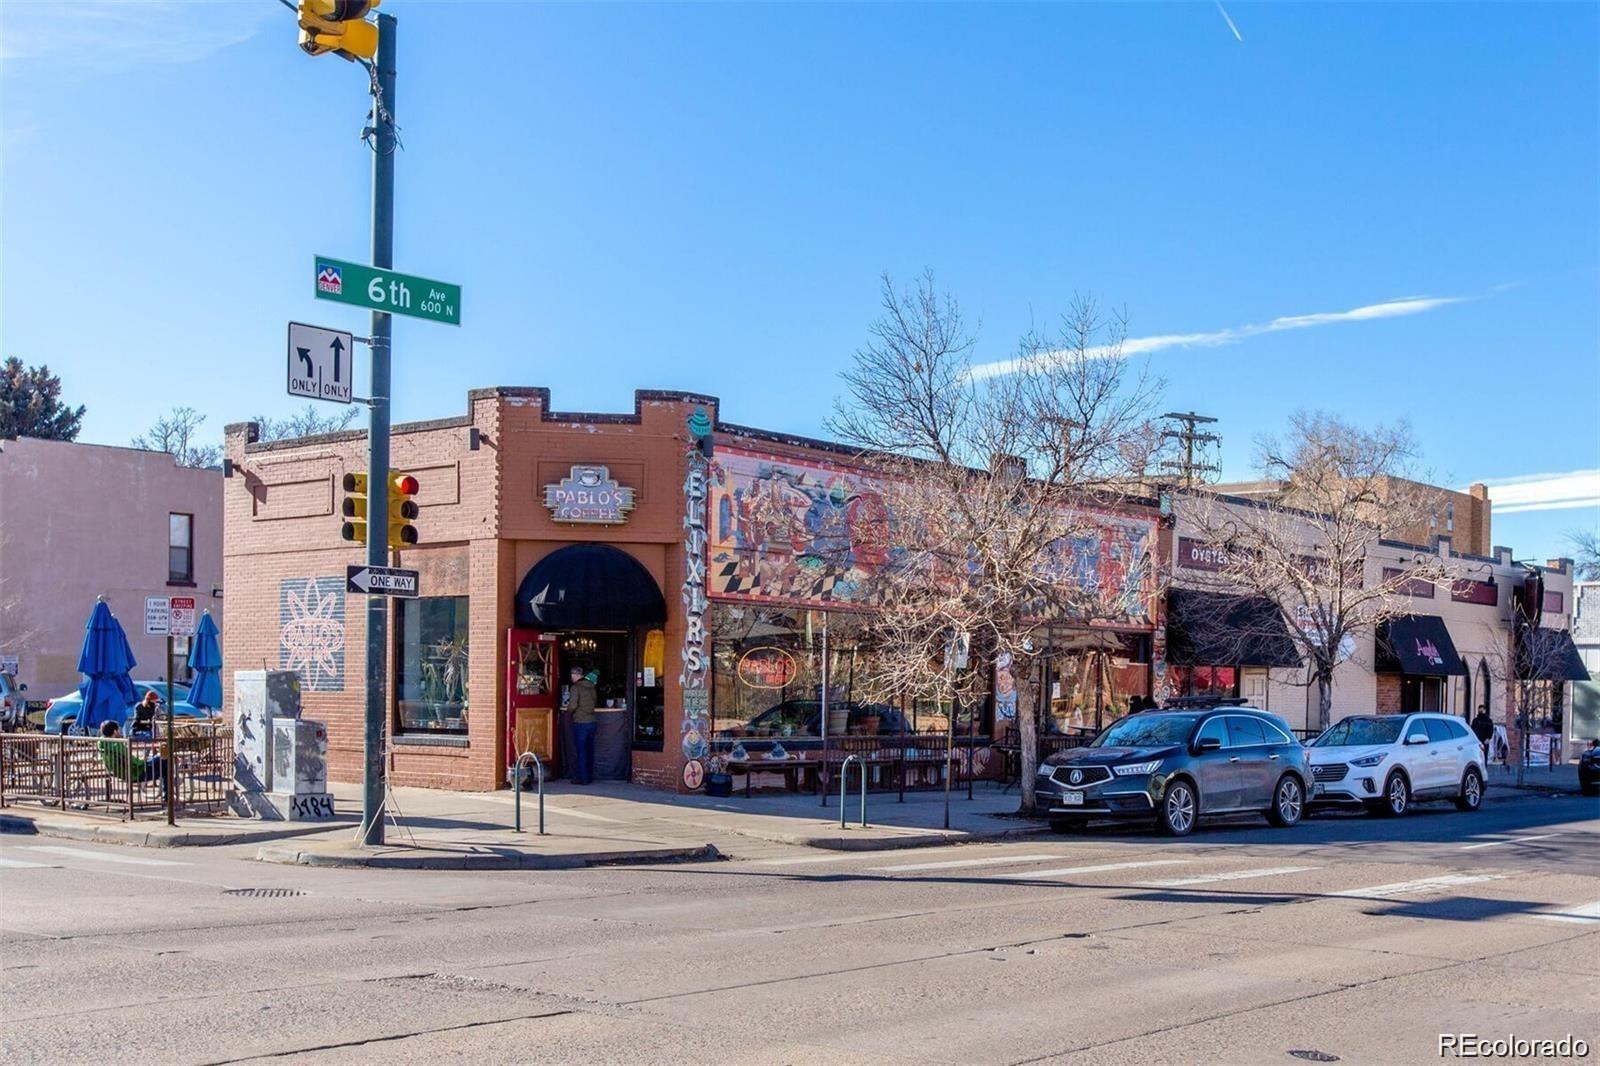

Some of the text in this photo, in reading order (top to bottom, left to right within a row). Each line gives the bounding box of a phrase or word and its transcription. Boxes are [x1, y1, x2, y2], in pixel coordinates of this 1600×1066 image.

[318, 281, 342, 295] DENVER
[368, 277, 411, 308] 6th
[429, 288, 446, 302] Ave
[420, 300, 453, 317] 600 N
[291, 378, 318, 393] ONLY
[324, 384, 349, 398] ONLY
[555, 490, 623, 506] PABLO'S
[687, 469, 702, 673] ELIXIRS
[370, 575, 413, 589] ONE WAY
